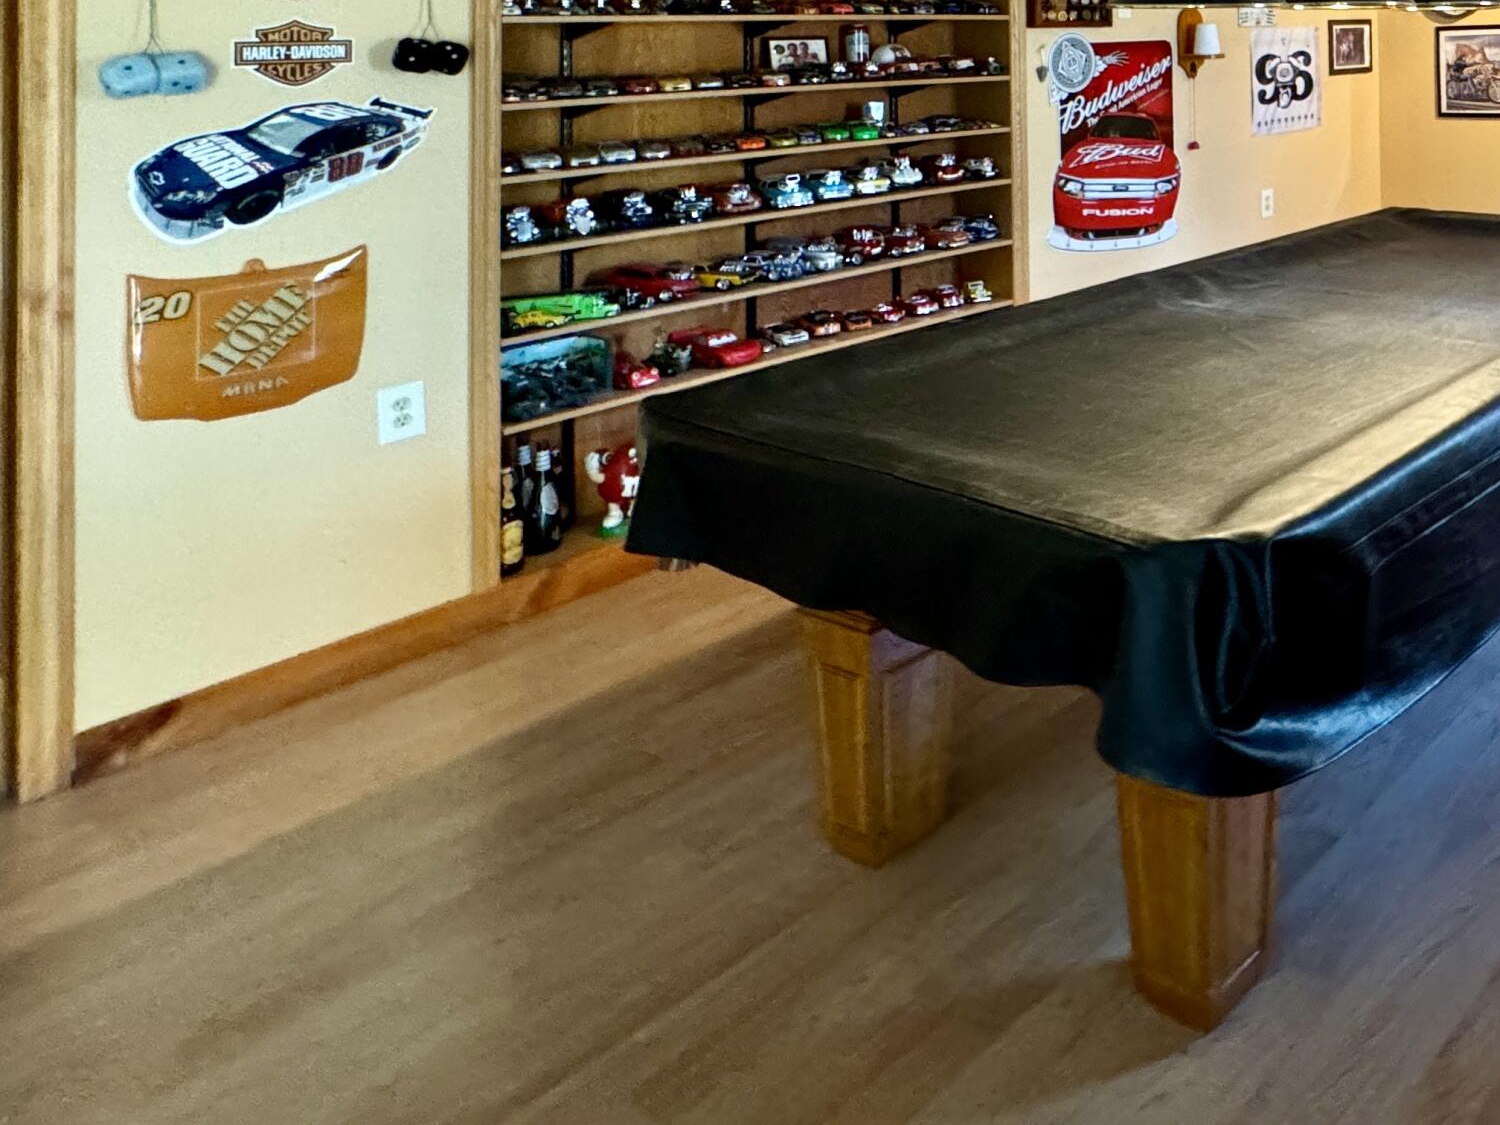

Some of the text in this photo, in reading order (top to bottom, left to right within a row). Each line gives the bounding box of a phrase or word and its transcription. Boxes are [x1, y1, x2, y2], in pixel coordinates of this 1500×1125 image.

[268, 27, 321, 42] MOTOR
[242, 45, 346, 61] HARLEY-DAVIDSON
[267, 64, 322, 81] CYCLES
[1058, 56, 1172, 135] Budweiser
[173, 138, 260, 190] GUARD
[327, 151, 365, 183] 88
[1078, 143, 1162, 165] Bud
[1082, 207, 1155, 217] FUSION
[134, 290, 194, 326] 20
[198, 282, 312, 377] HOME
